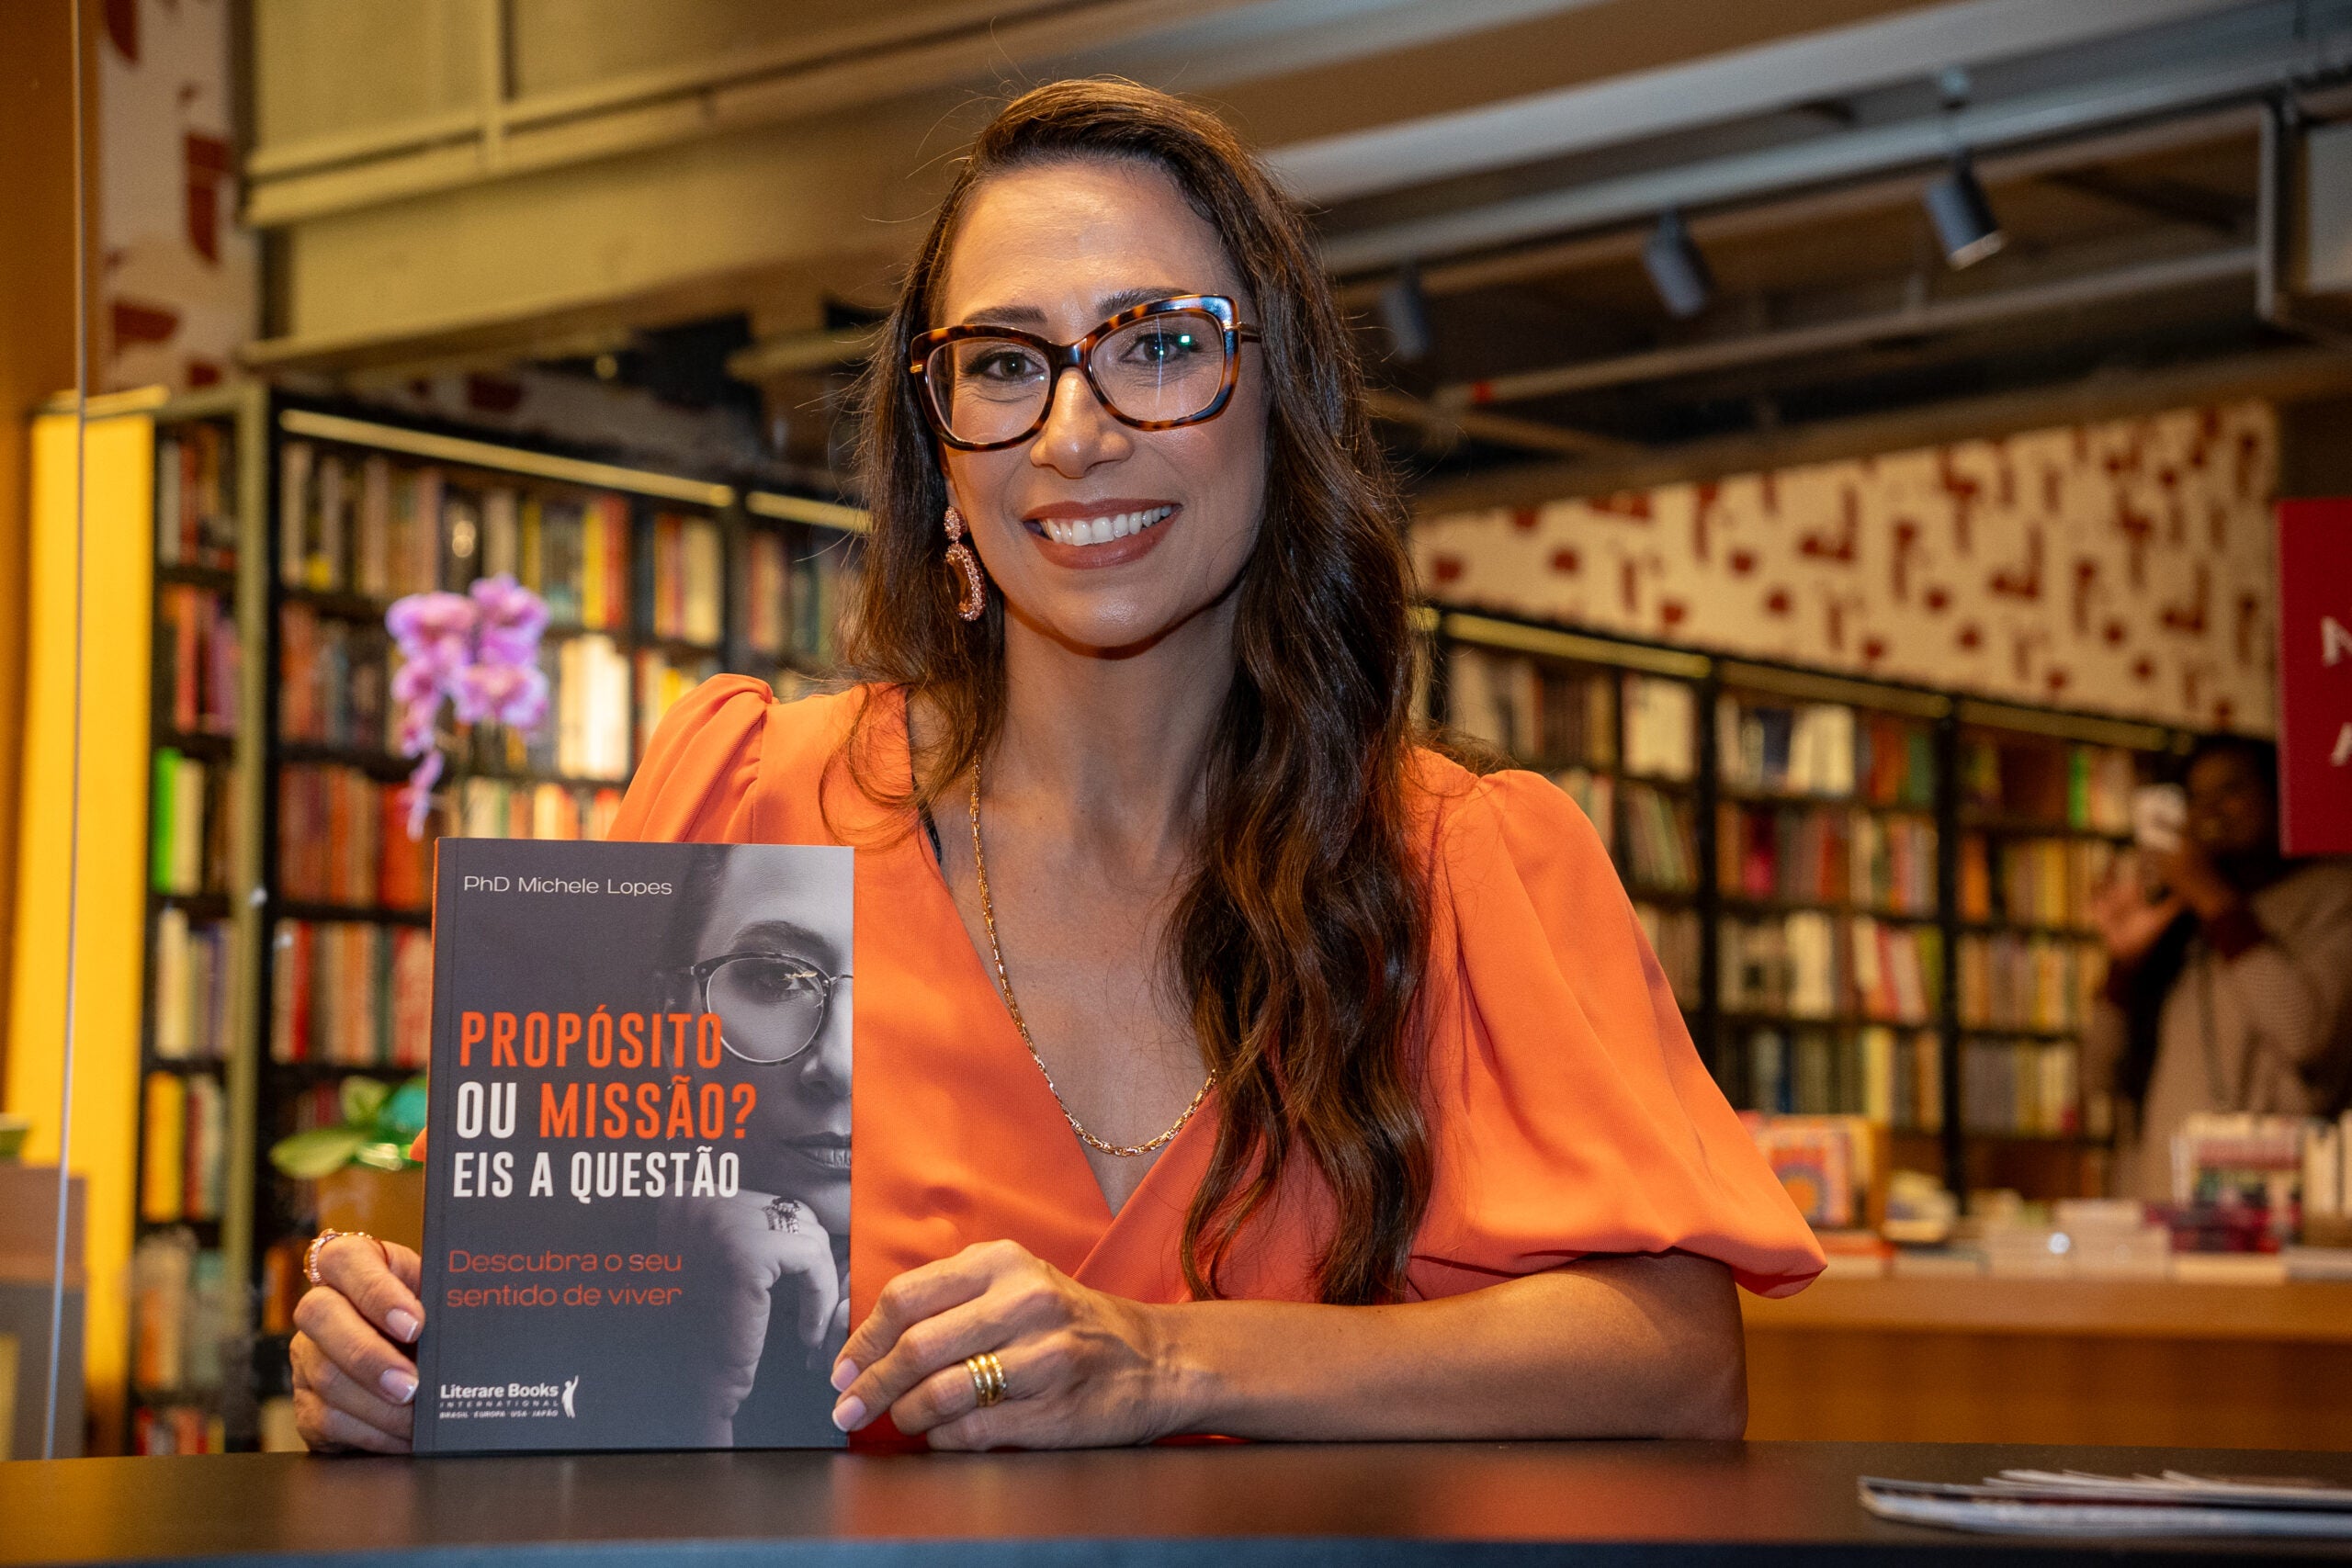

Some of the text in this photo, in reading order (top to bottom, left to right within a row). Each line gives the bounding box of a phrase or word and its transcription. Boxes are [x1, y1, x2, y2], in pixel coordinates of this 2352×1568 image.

[464, 875, 673, 897] PhD Michele Lopes
[459, 1003, 723, 1068] PROPÓSITO
[456, 1074, 757, 1139] OU MISSÃO?
[453, 1145, 740, 1204] EIS A QUESTÃO
[447, 1249, 683, 1273] Descubra o seu
[447, 1283, 683, 1307] sentido de viver
[440, 1382, 559, 1399] Literare Books
[439, 1400, 559, 1408] INTERNATIONAL
